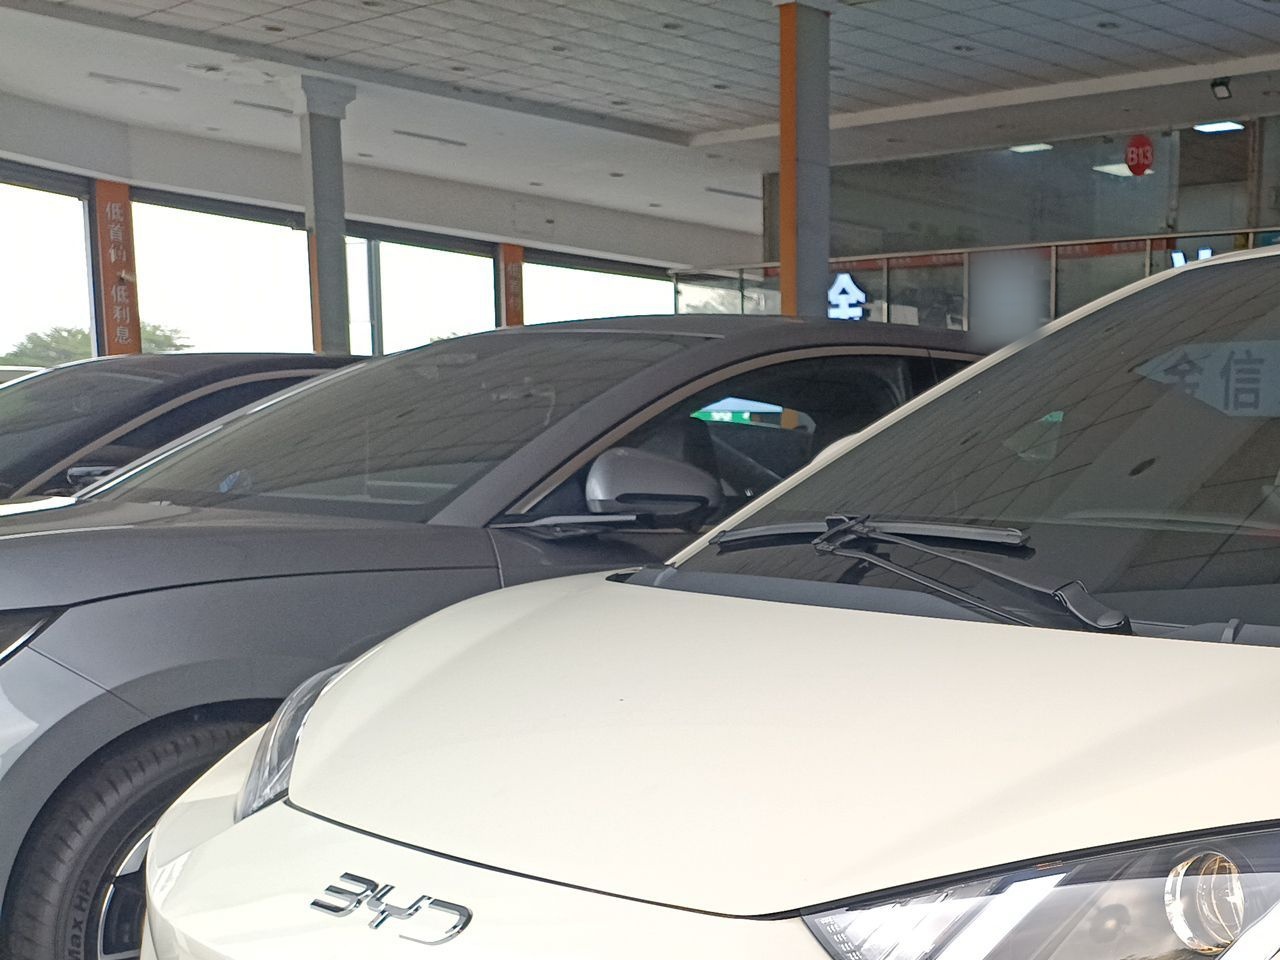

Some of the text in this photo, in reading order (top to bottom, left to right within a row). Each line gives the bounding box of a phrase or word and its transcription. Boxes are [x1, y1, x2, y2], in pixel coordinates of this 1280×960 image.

[111, 285, 132, 345] 低利息
[309, 872, 474, 946] BYD
